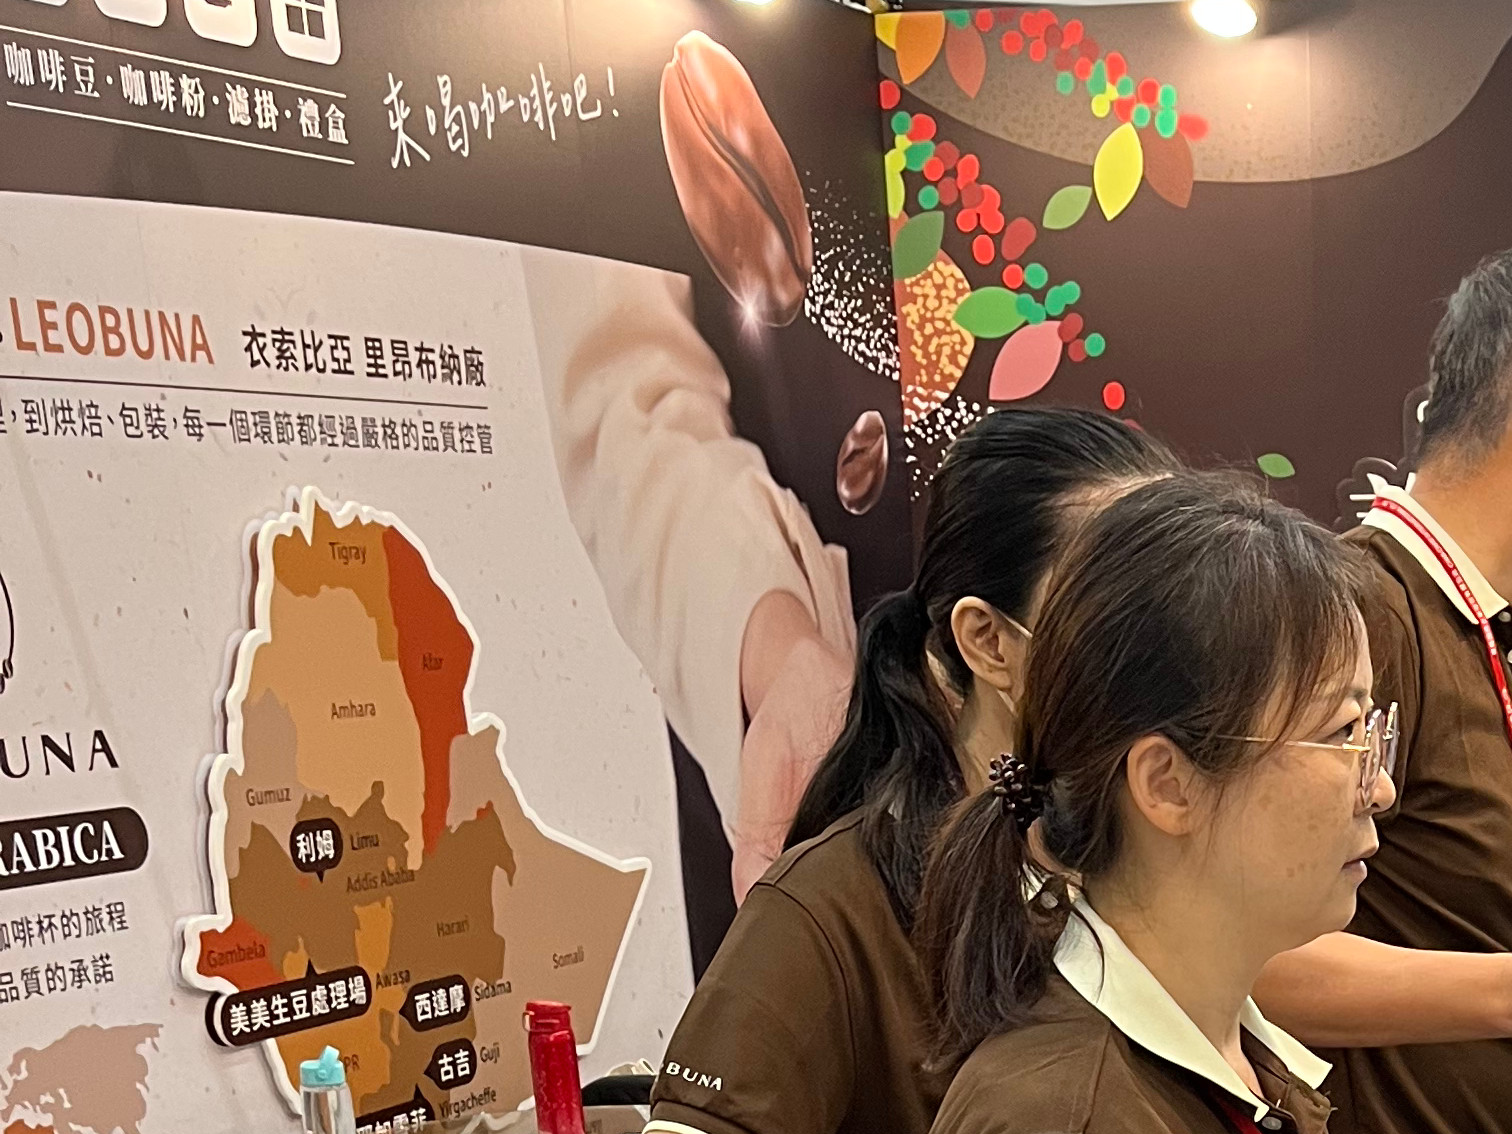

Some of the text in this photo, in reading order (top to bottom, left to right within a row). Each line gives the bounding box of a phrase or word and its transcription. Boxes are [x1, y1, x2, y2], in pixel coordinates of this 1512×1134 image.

[9, 297, 215, 365] LEOBUNA
[241, 324, 487, 387] 衣索比亞 里昂布納廠
[329, 542, 366, 565] Tigray
[331, 700, 376, 720] Amhara
[246, 787, 291, 806] Gumuz
[296, 829, 335, 863] 利姆
[351, 832, 379, 850] Limu
[346, 869, 415, 892] Addis Ababa
[552, 947, 584, 969] Somali
[376, 969, 410, 990] Awasa
[475, 979, 512, 1002] Sidama
[229, 975, 367, 1036] 美美生豆處理場
[414, 984, 466, 1022] 西達摩
[480, 1042, 500, 1063] Guji
[438, 1049, 471, 1082] 古吉
[661, 1061, 722, 1091] BUNA
[439, 1088, 497, 1120] Yirgacheffe
